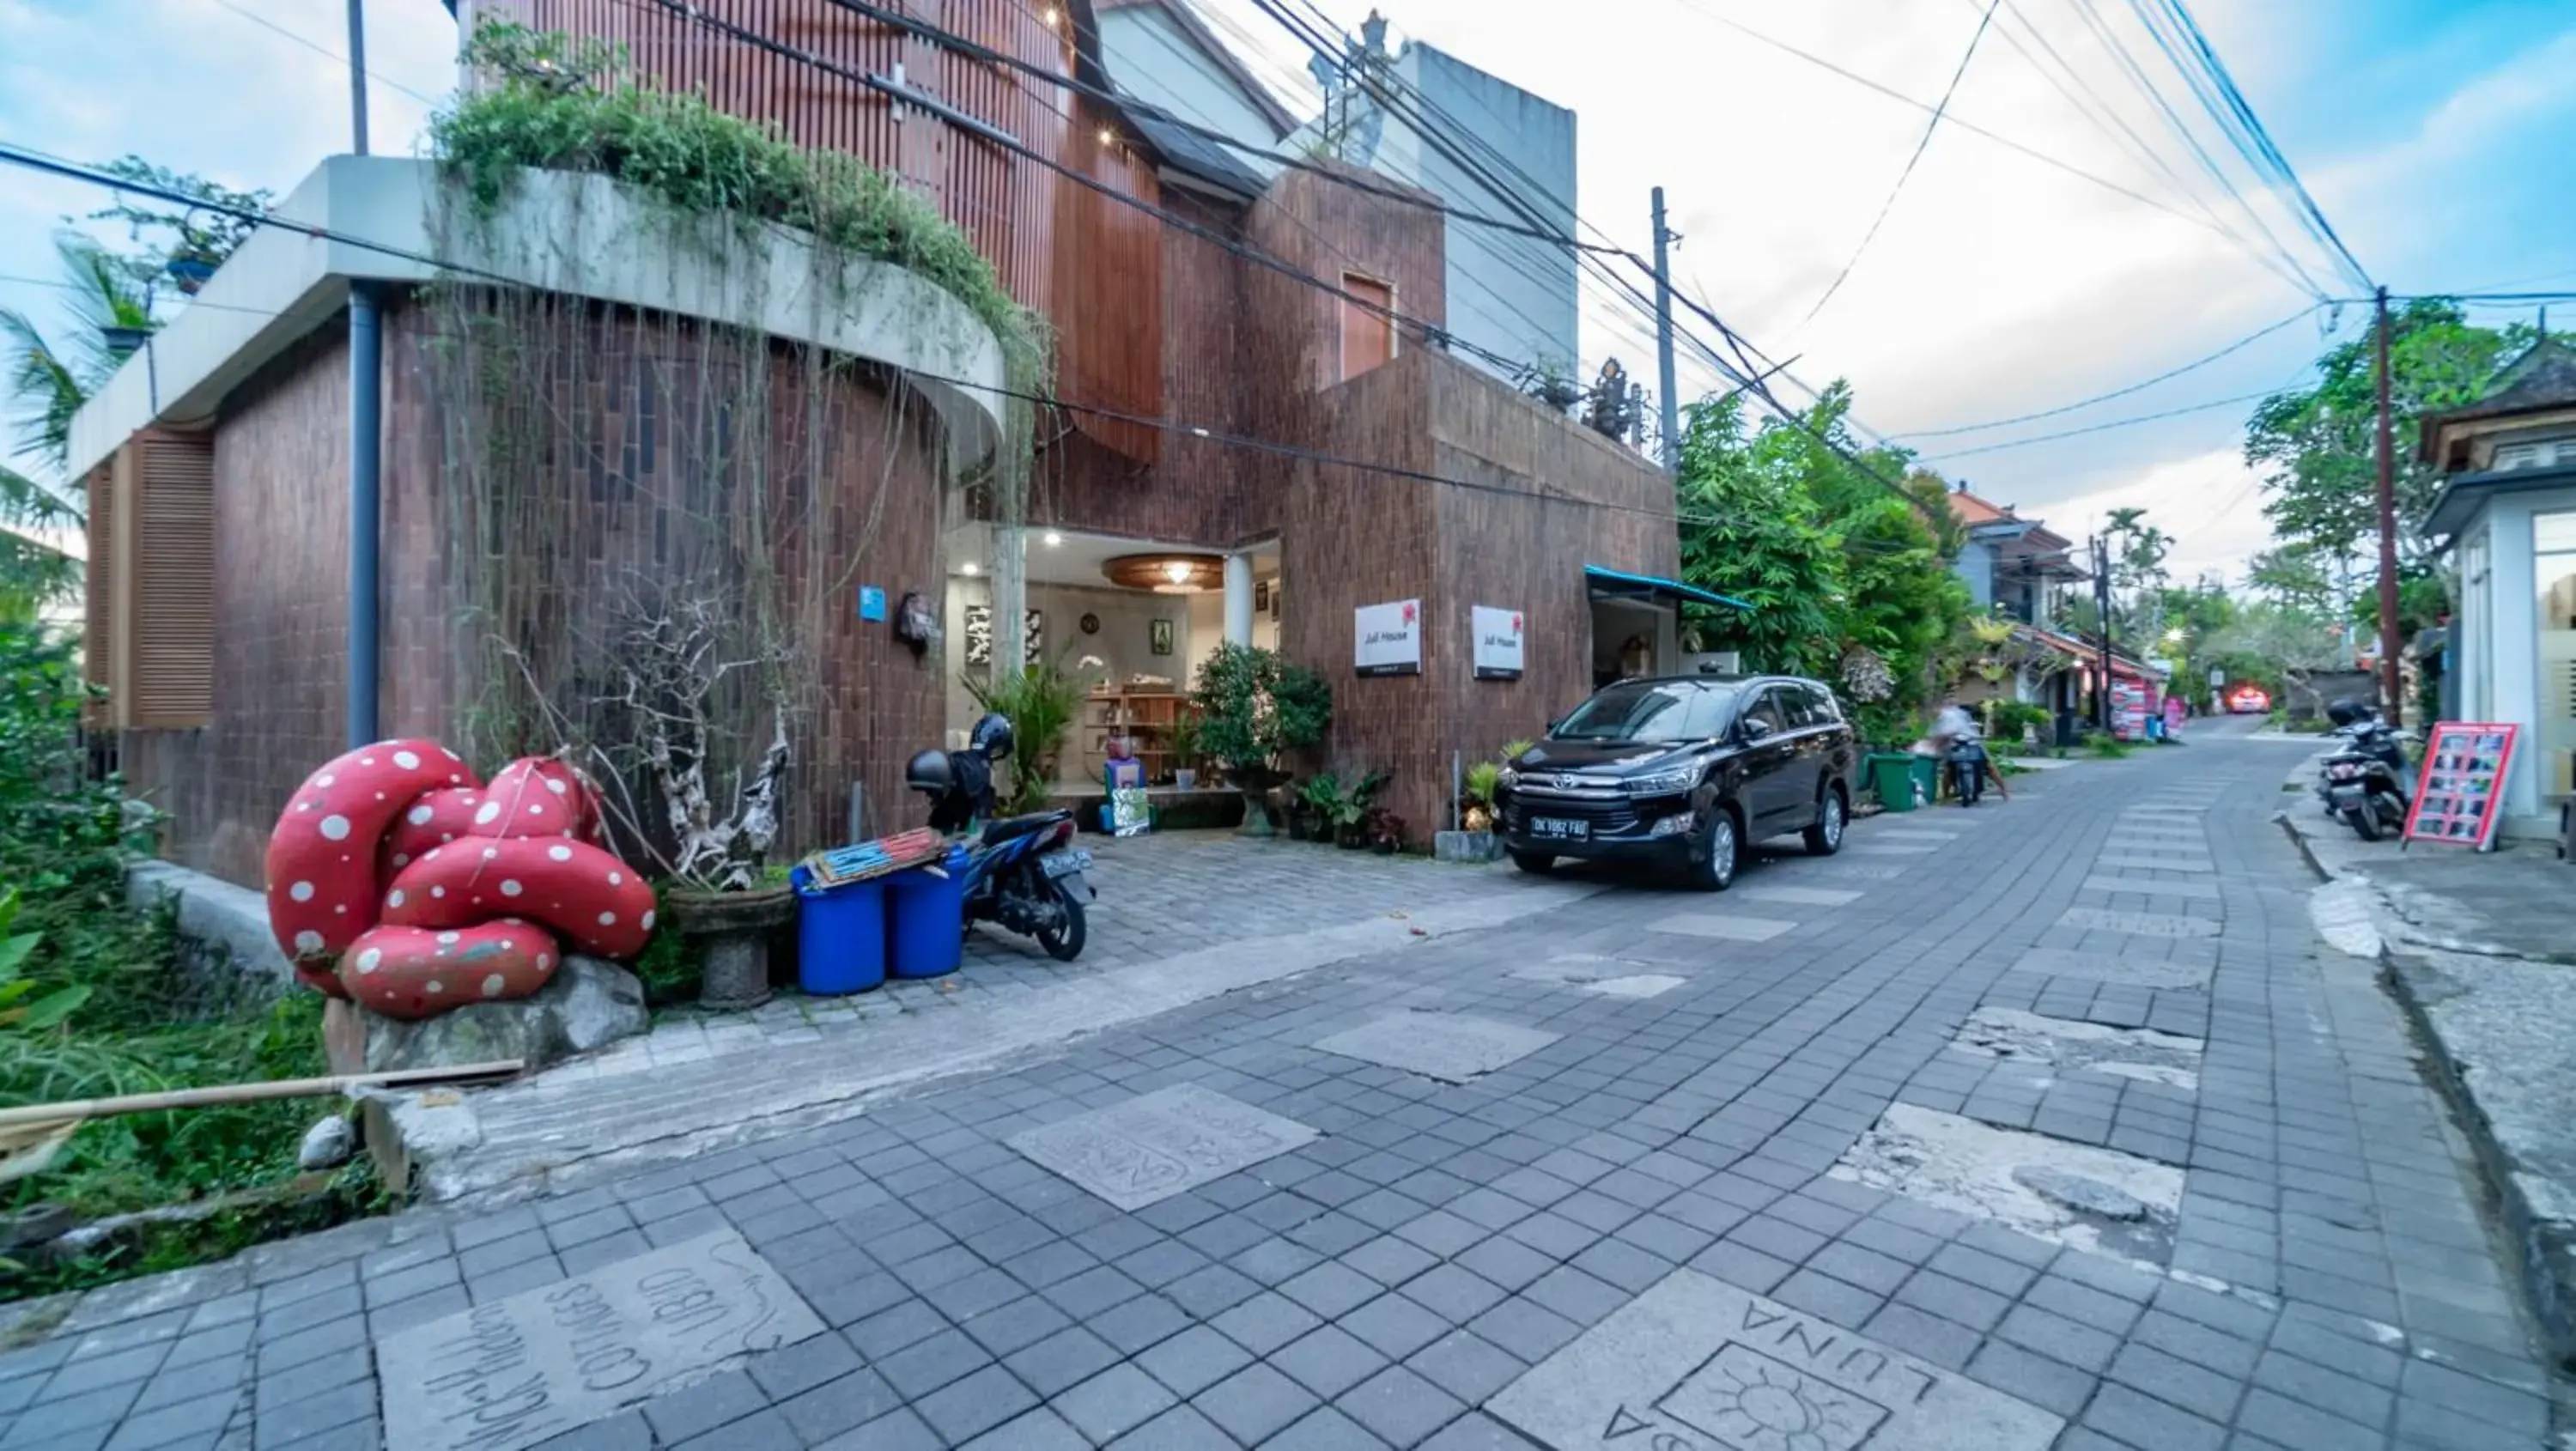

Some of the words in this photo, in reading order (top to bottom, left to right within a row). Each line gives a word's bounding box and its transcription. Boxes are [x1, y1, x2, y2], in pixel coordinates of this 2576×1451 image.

[544, 1284, 653, 1391] COTTAGES
[637, 1267, 729, 1338] UBUD
[1741, 1299, 1939, 1405] LUNA
